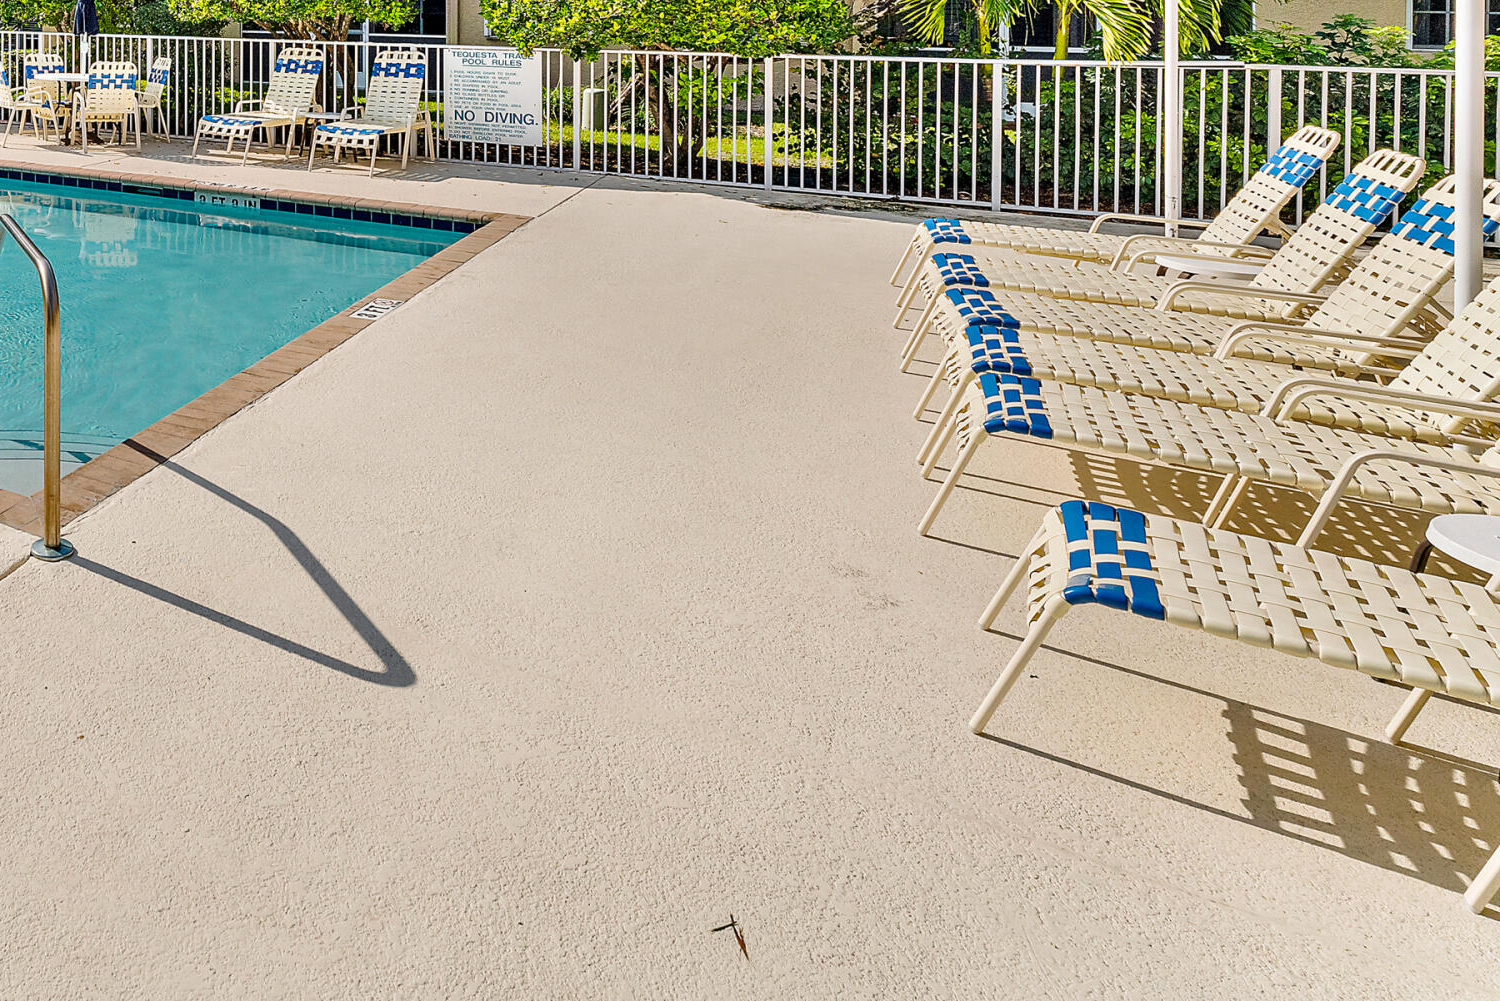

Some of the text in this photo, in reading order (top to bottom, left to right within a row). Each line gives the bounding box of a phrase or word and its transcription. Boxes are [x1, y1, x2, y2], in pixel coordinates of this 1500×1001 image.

[452, 51, 498, 59] TEQUESTA
[454, 109, 476, 122] NO
[484, 111, 539, 126] DIVING.
